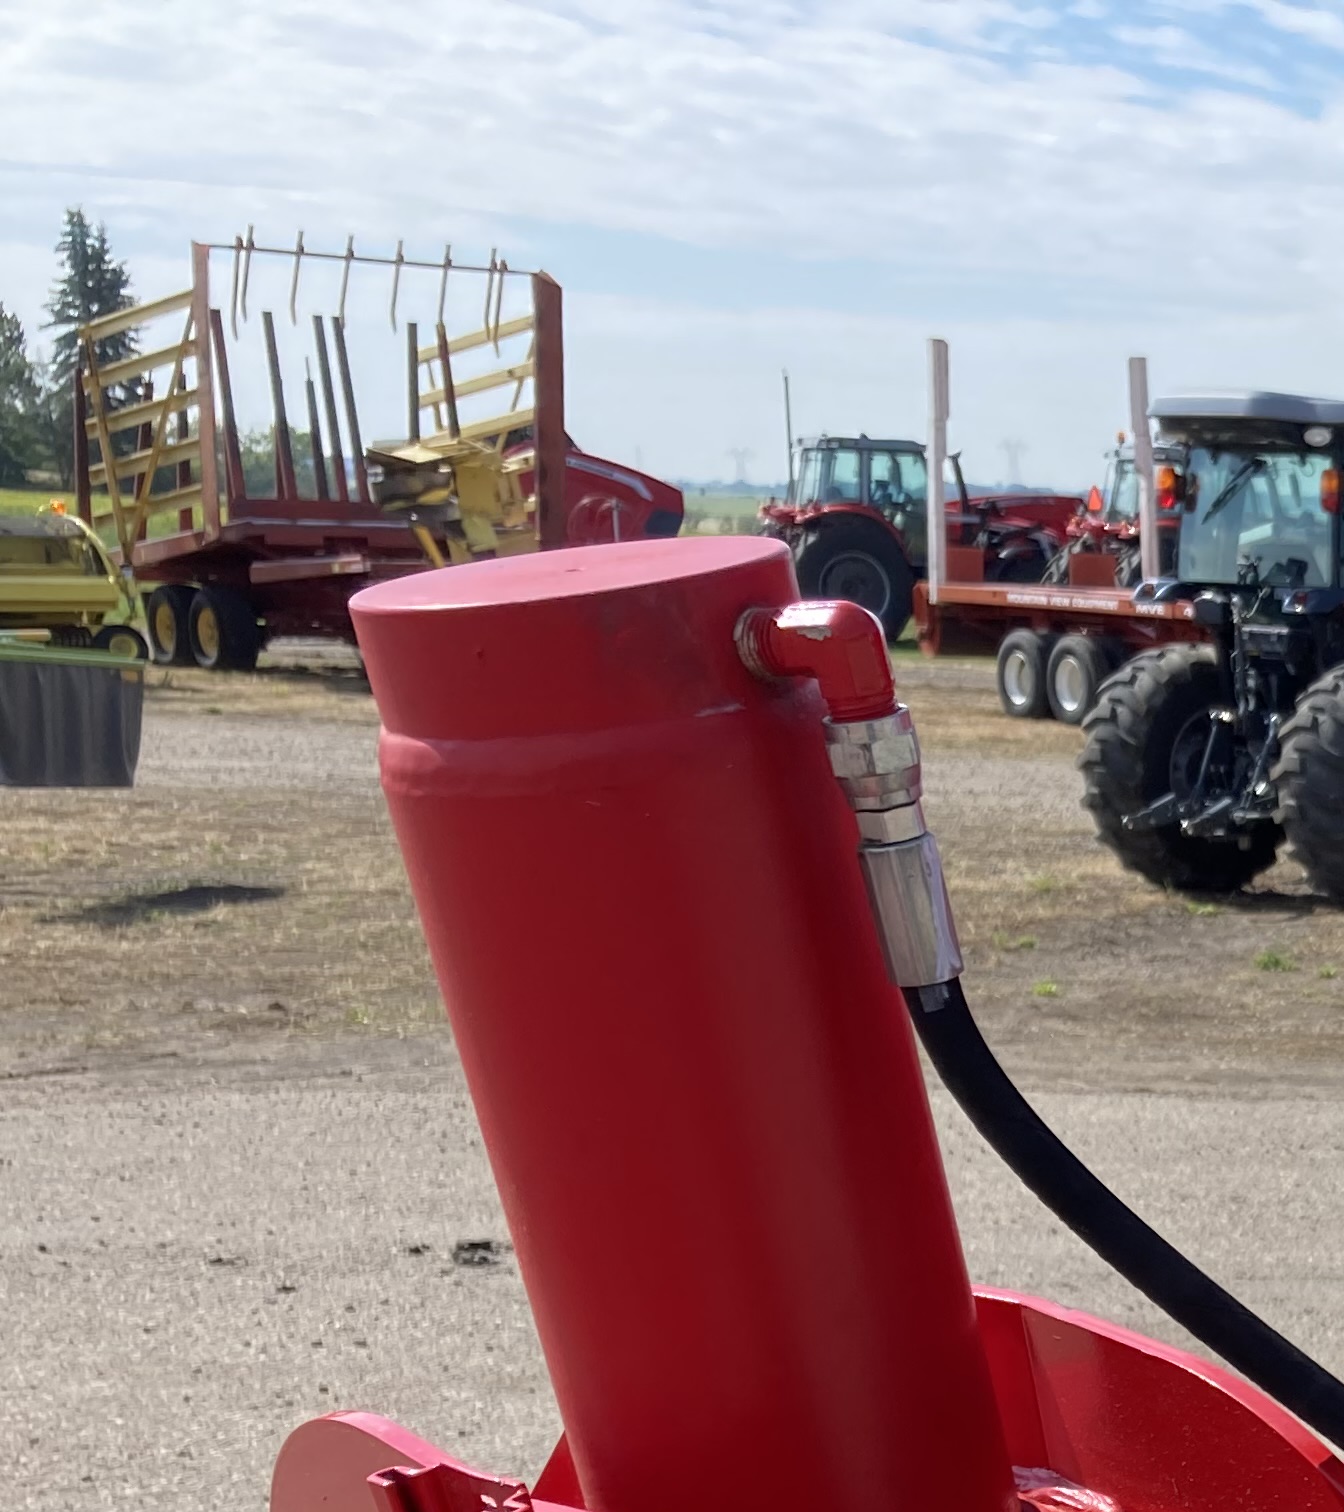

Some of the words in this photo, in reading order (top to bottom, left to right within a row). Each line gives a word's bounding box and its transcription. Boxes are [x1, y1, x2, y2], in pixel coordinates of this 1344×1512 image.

[1006, 593, 1047, 605] MOUNTAIN
[1050, 596, 1070, 607] VIEW
[1072, 598, 1119, 610] EQUIPMENT
[1136, 604, 1165, 615] MVE
